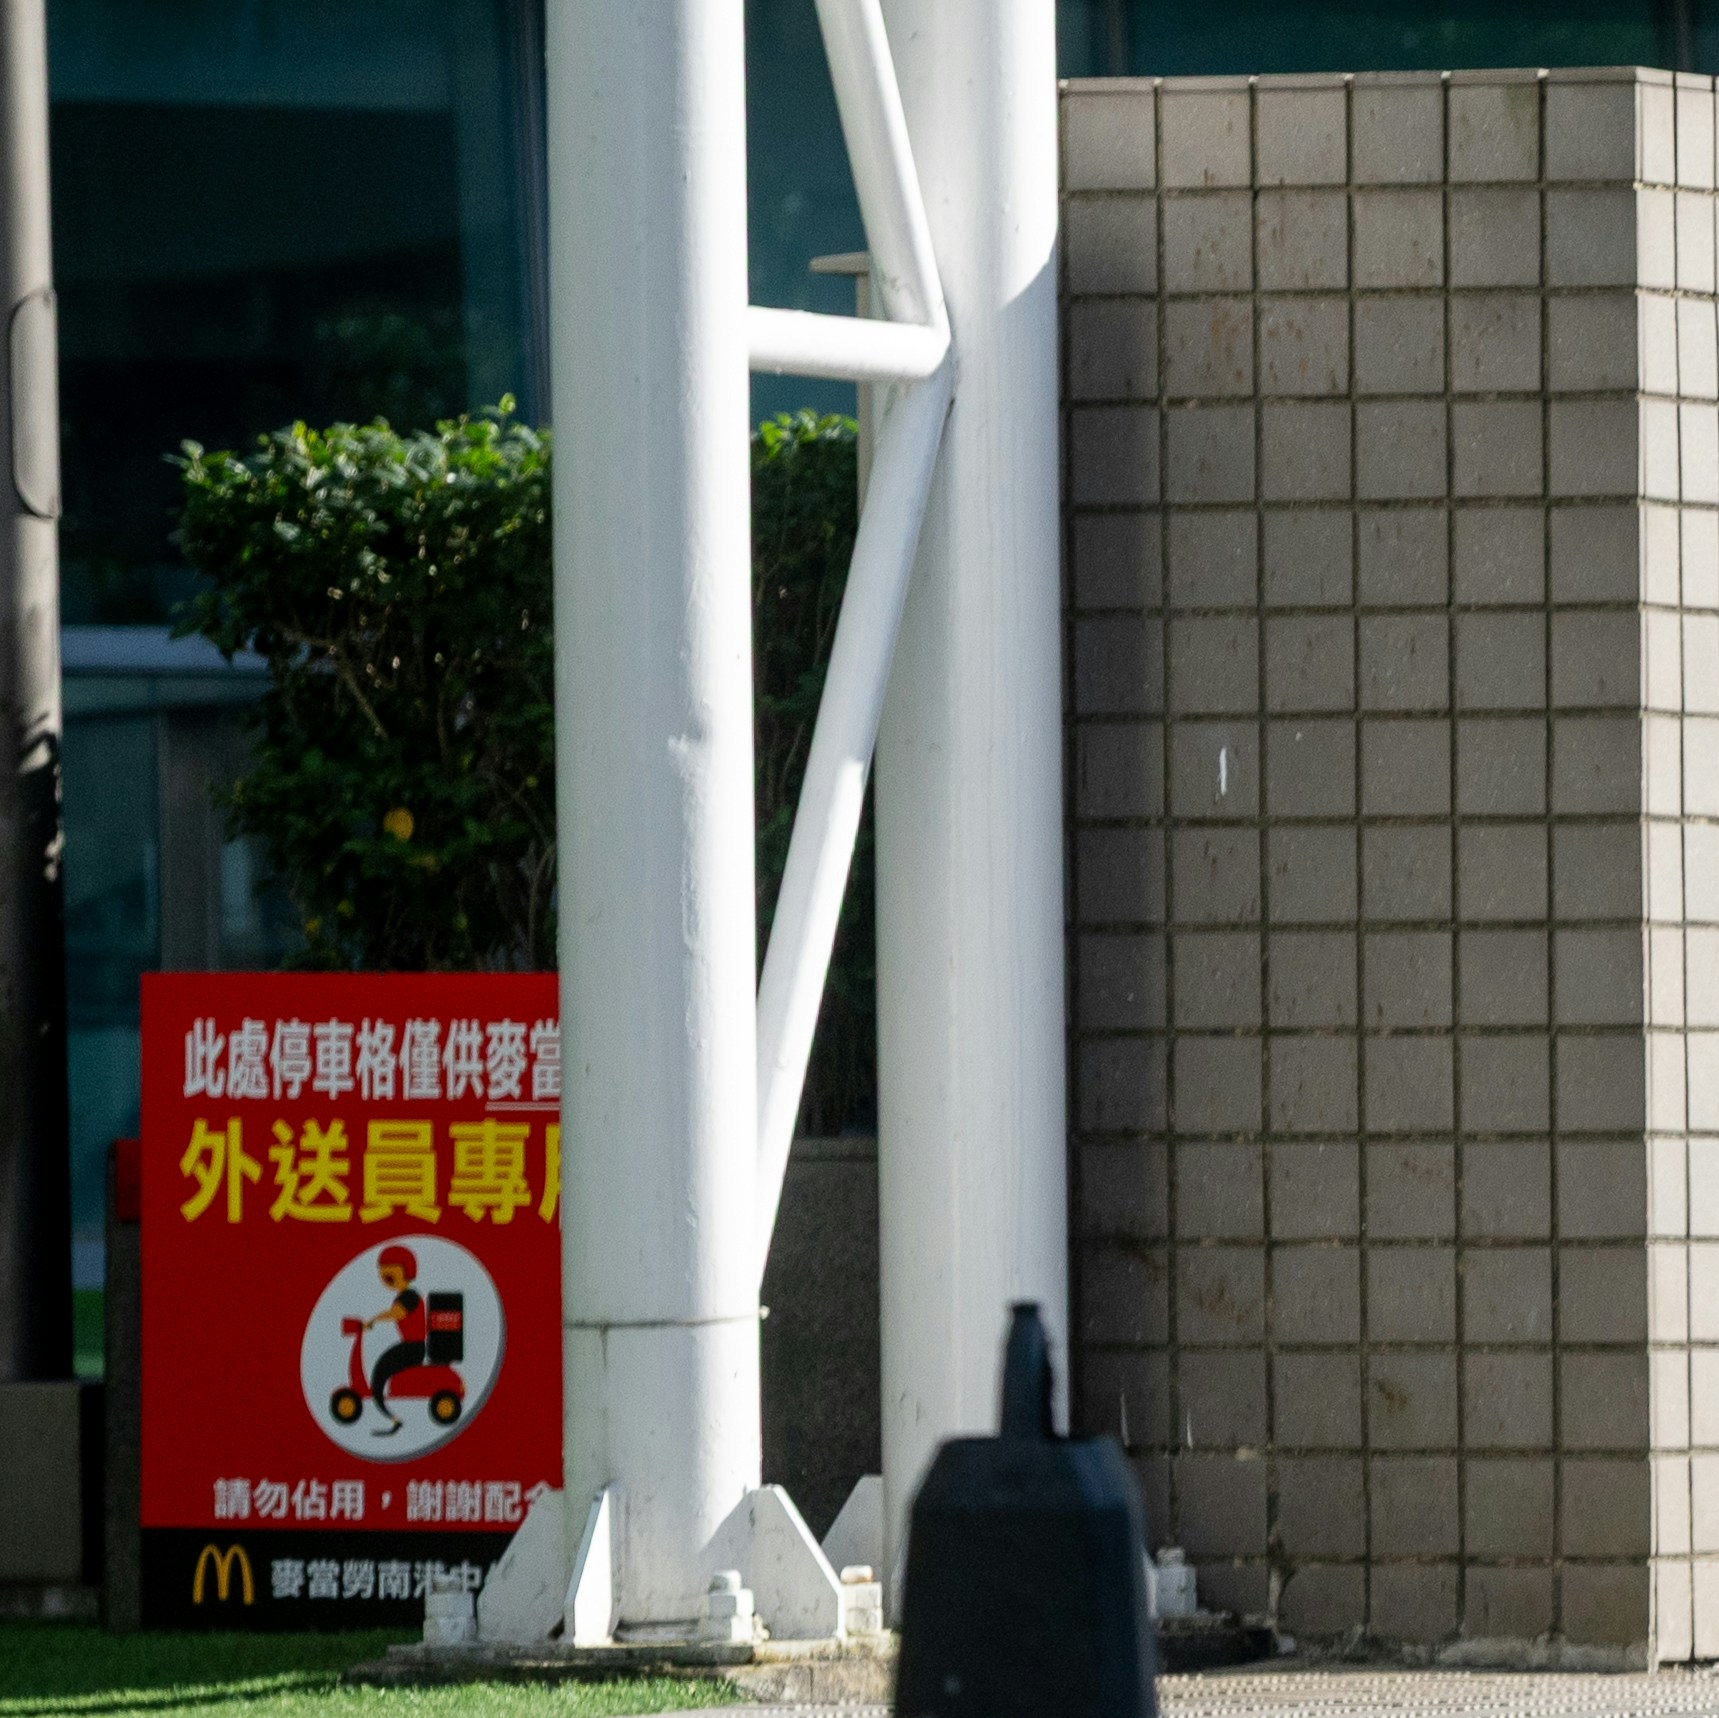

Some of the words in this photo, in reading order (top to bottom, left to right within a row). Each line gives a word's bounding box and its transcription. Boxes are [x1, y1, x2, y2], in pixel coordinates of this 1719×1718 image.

[270, 1558, 498, 1600] 麥當勞南中
